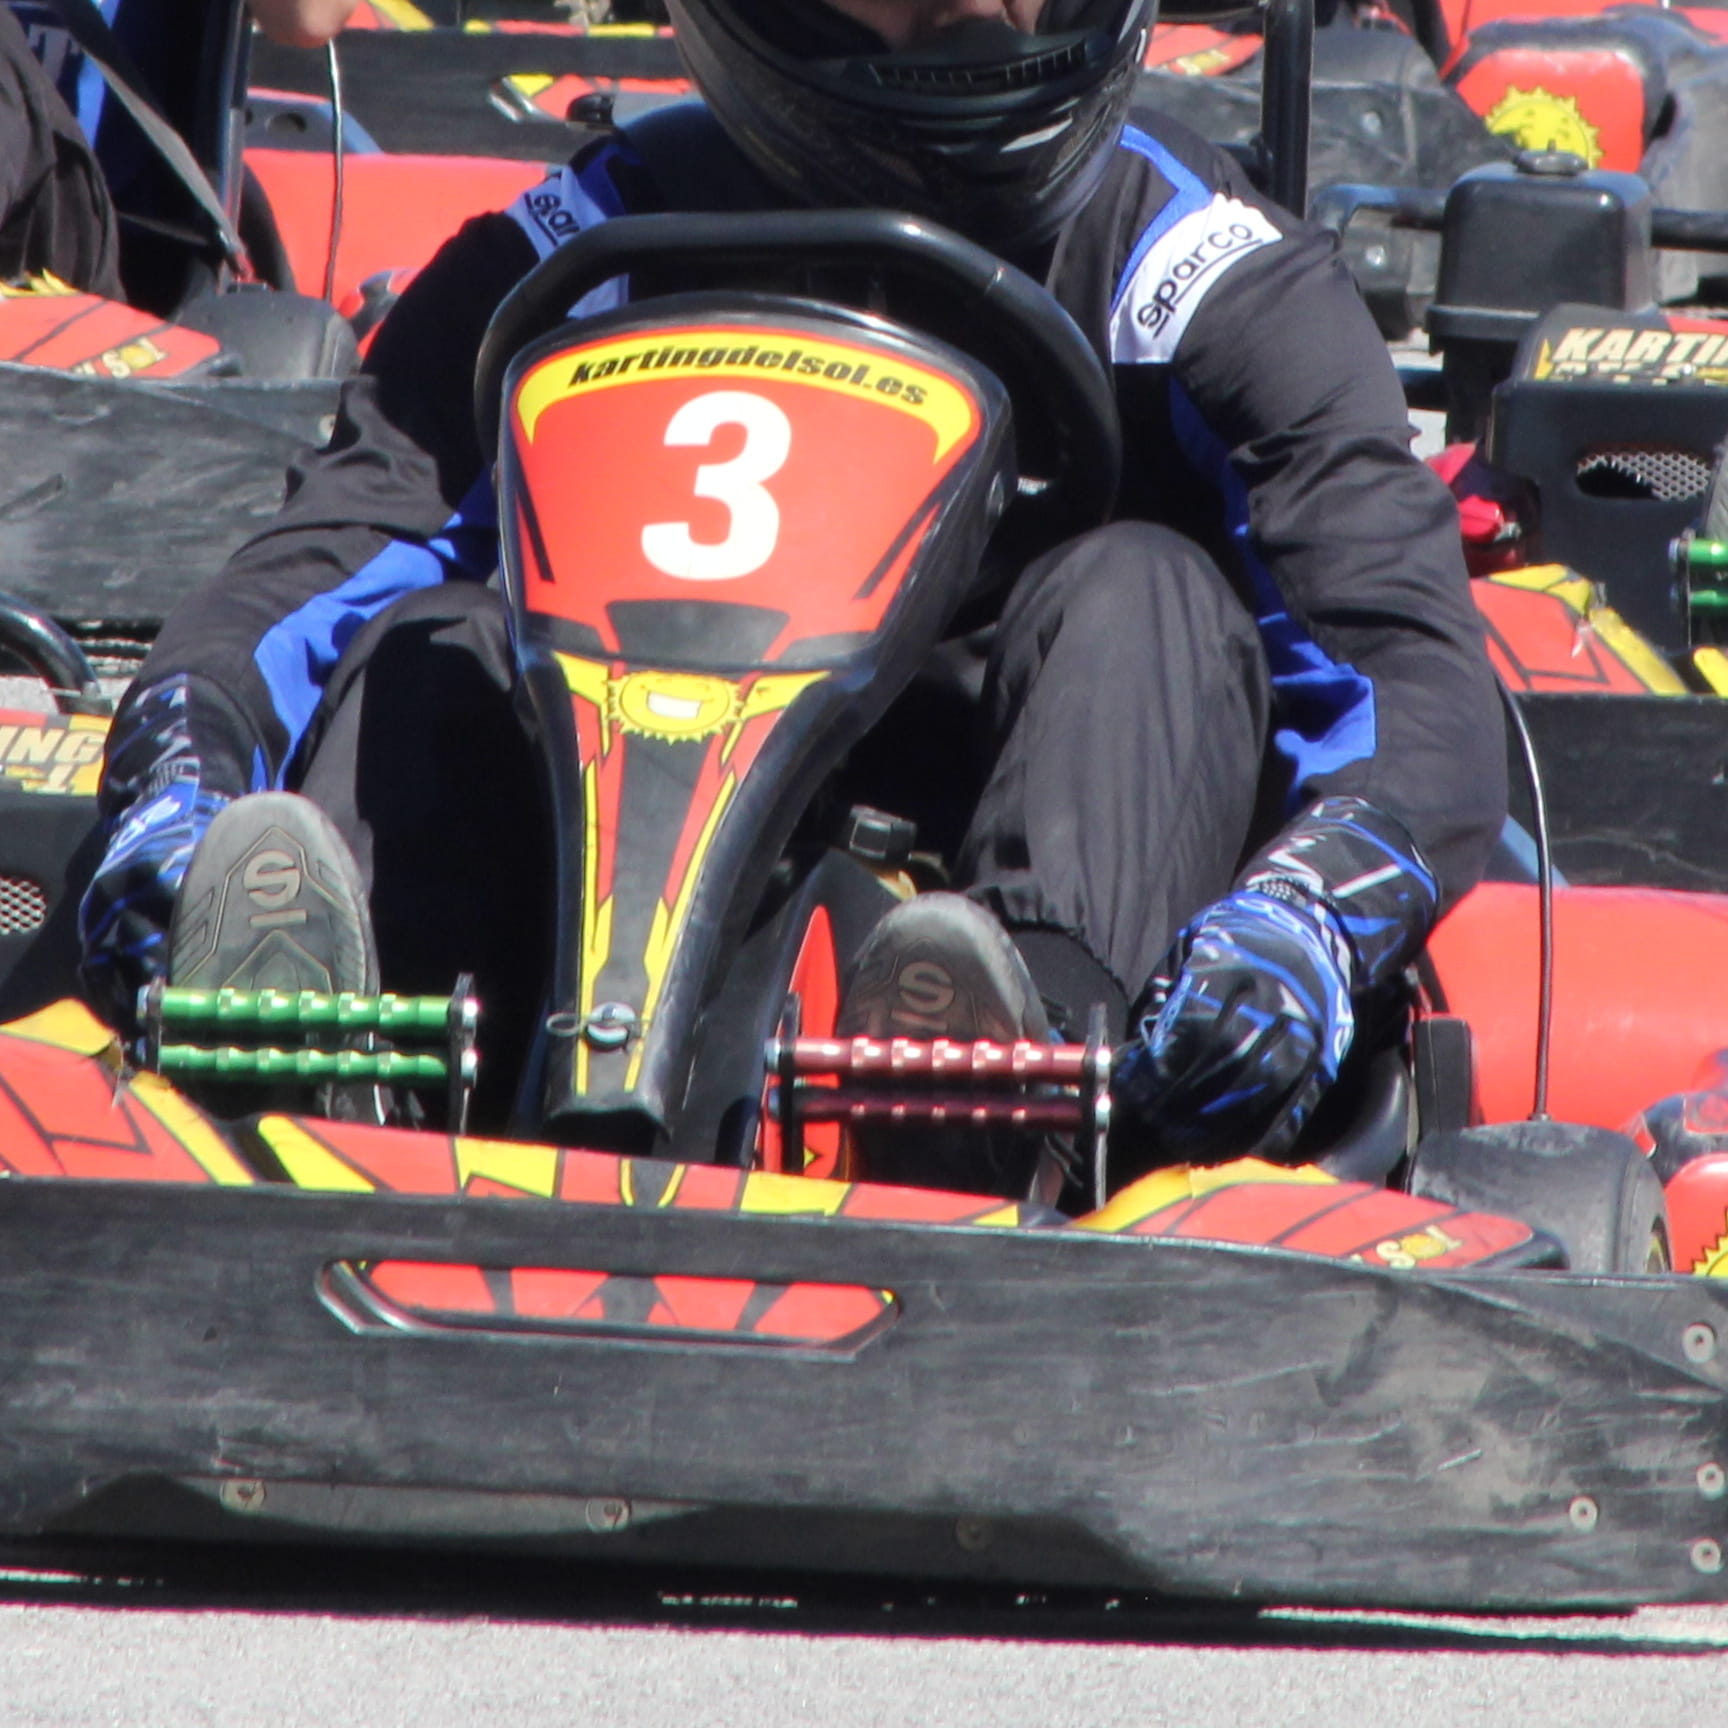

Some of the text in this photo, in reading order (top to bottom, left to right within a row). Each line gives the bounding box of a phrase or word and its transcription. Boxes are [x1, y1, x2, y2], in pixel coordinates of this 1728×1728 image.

[1136, 222, 1255, 332] sparco
[568, 345, 927, 408] kartingdelsol.es
[641, 389, 793, 582] 3
